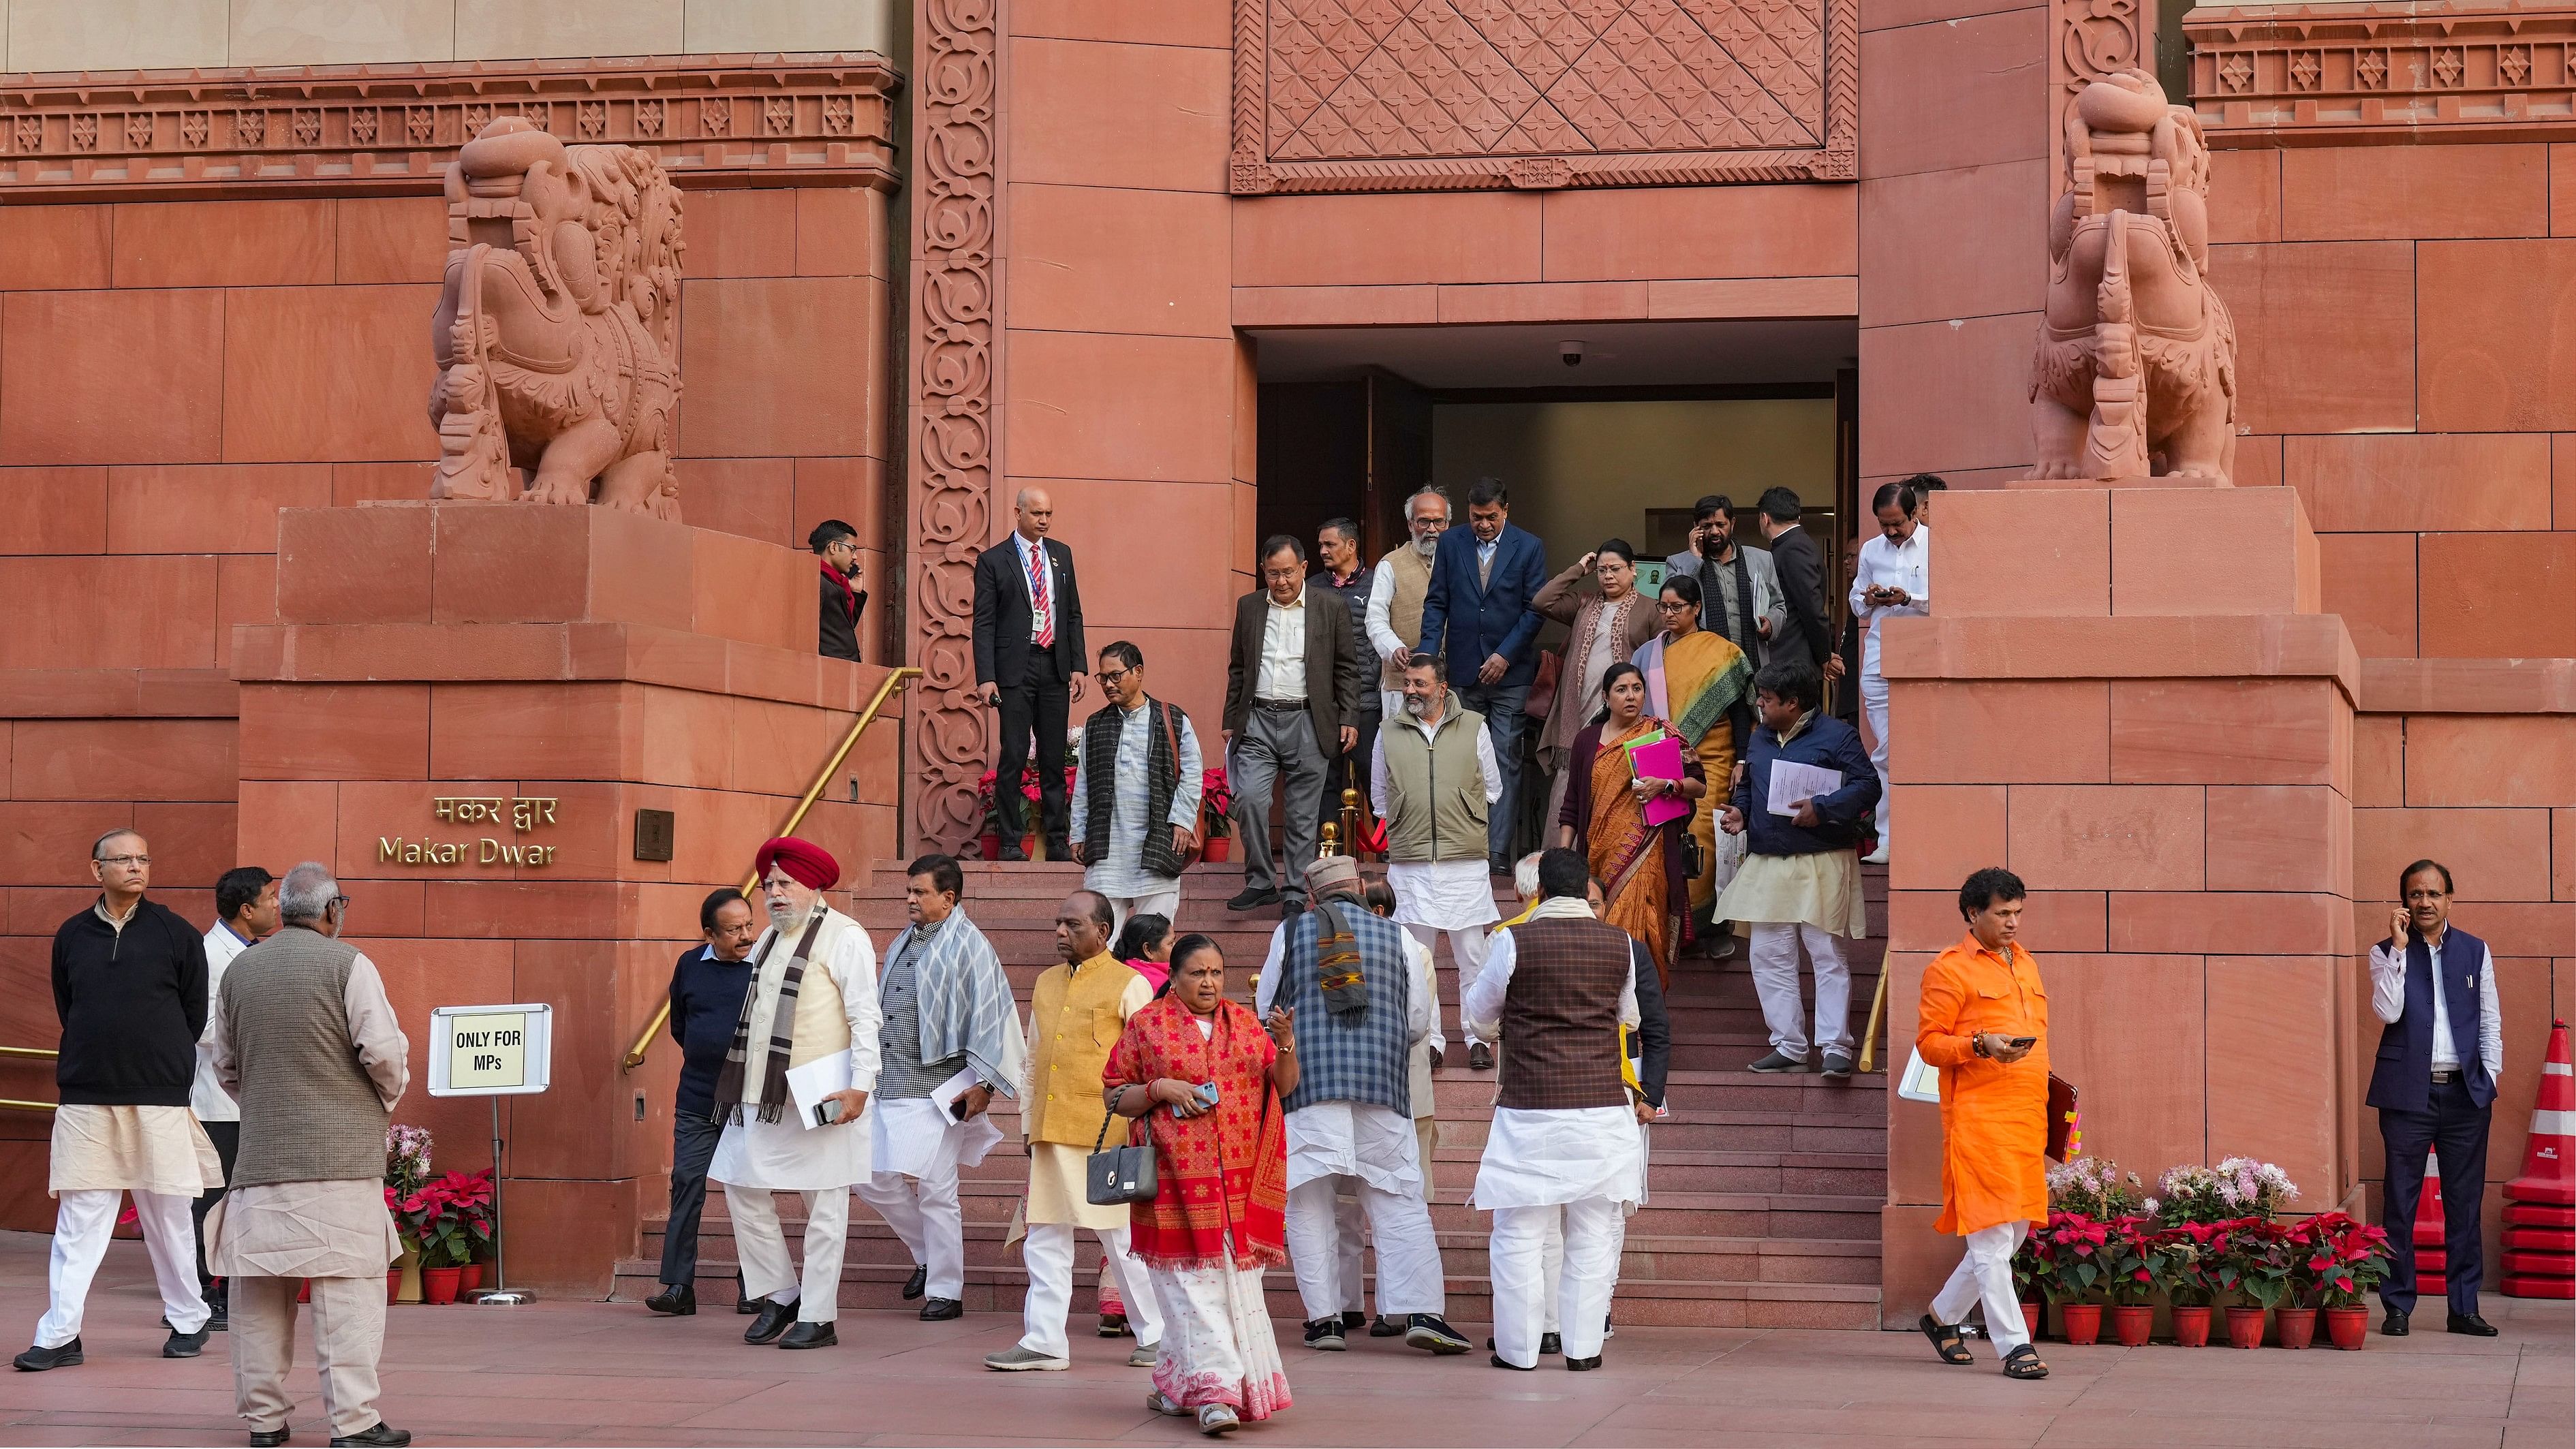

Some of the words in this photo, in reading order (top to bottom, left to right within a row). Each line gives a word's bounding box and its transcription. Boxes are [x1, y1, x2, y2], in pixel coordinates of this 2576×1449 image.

[434, 797, 503, 823] मकर
[511, 797, 558, 832] द्वार
[379, 837, 470, 864] Makar
[479, 838, 557, 864] Dwar
[456, 1032, 490, 1048] ONLY
[495, 1031, 521, 1046] FOR
[474, 1055, 501, 1070] MPs
